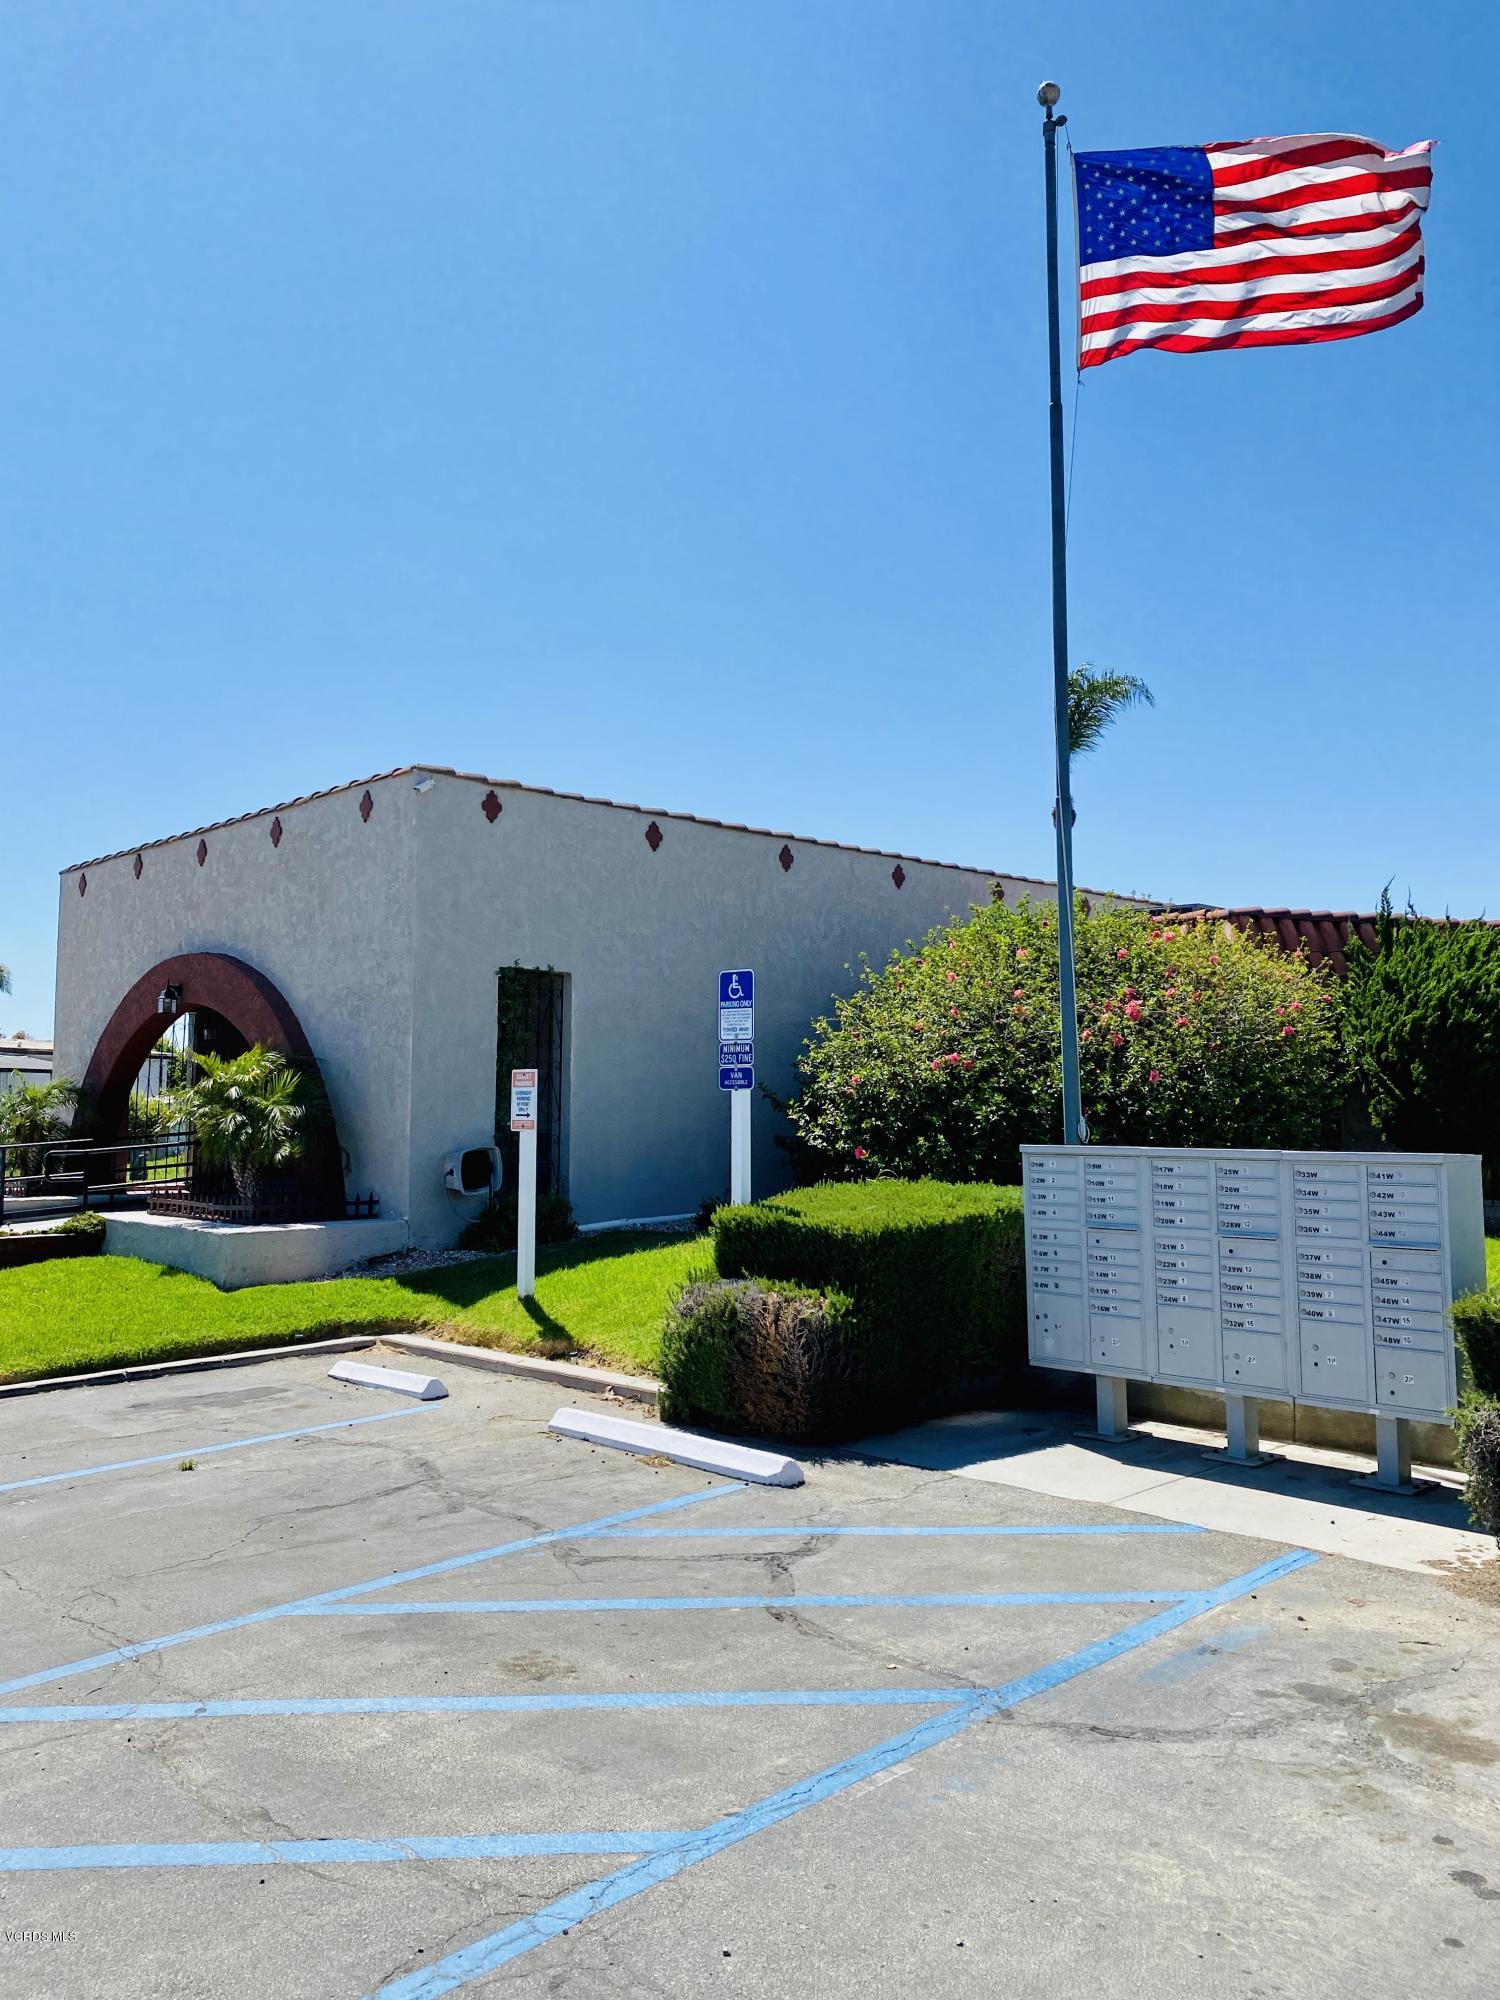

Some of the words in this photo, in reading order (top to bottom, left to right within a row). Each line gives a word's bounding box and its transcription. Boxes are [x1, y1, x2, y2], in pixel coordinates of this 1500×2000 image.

[723, 1044, 750, 1053] MINIMUM
[721, 1054, 736, 1063] $250
[739, 1054, 752, 1062] FINE
